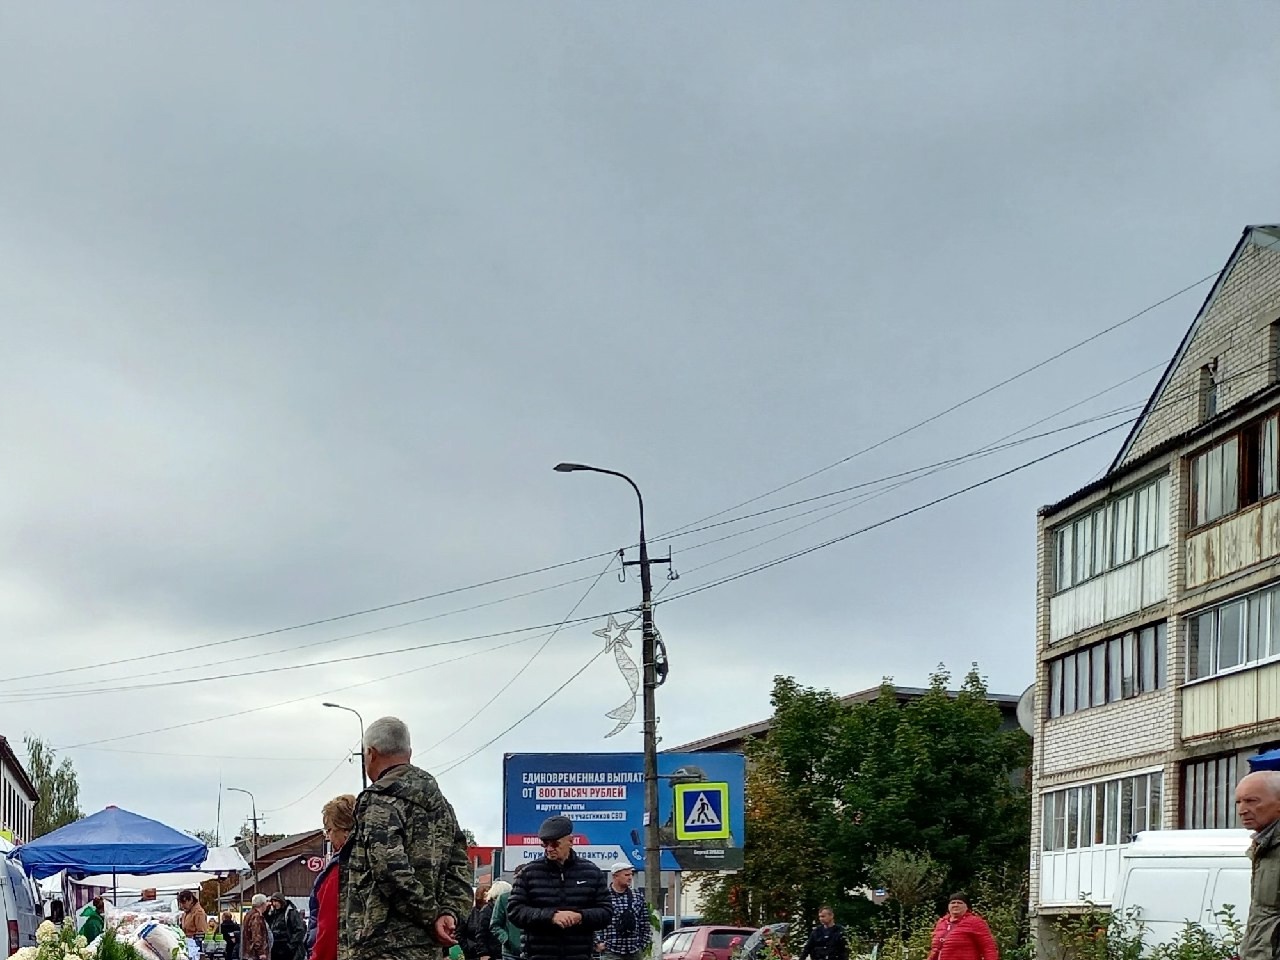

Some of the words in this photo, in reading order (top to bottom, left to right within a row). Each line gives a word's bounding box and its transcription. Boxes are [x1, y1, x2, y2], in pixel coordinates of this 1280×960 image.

[522, 772, 606, 784] ЕДИНОВРЕМЕННАЯ
[607, 772, 646, 783] ВЫПЛАТ
[522, 787, 534, 798] ОТ
[539, 787, 556, 798] 800
[557, 787, 587, 798] ТЫСЯЧ
[590, 786, 624, 798] РУБЛЕЙ
